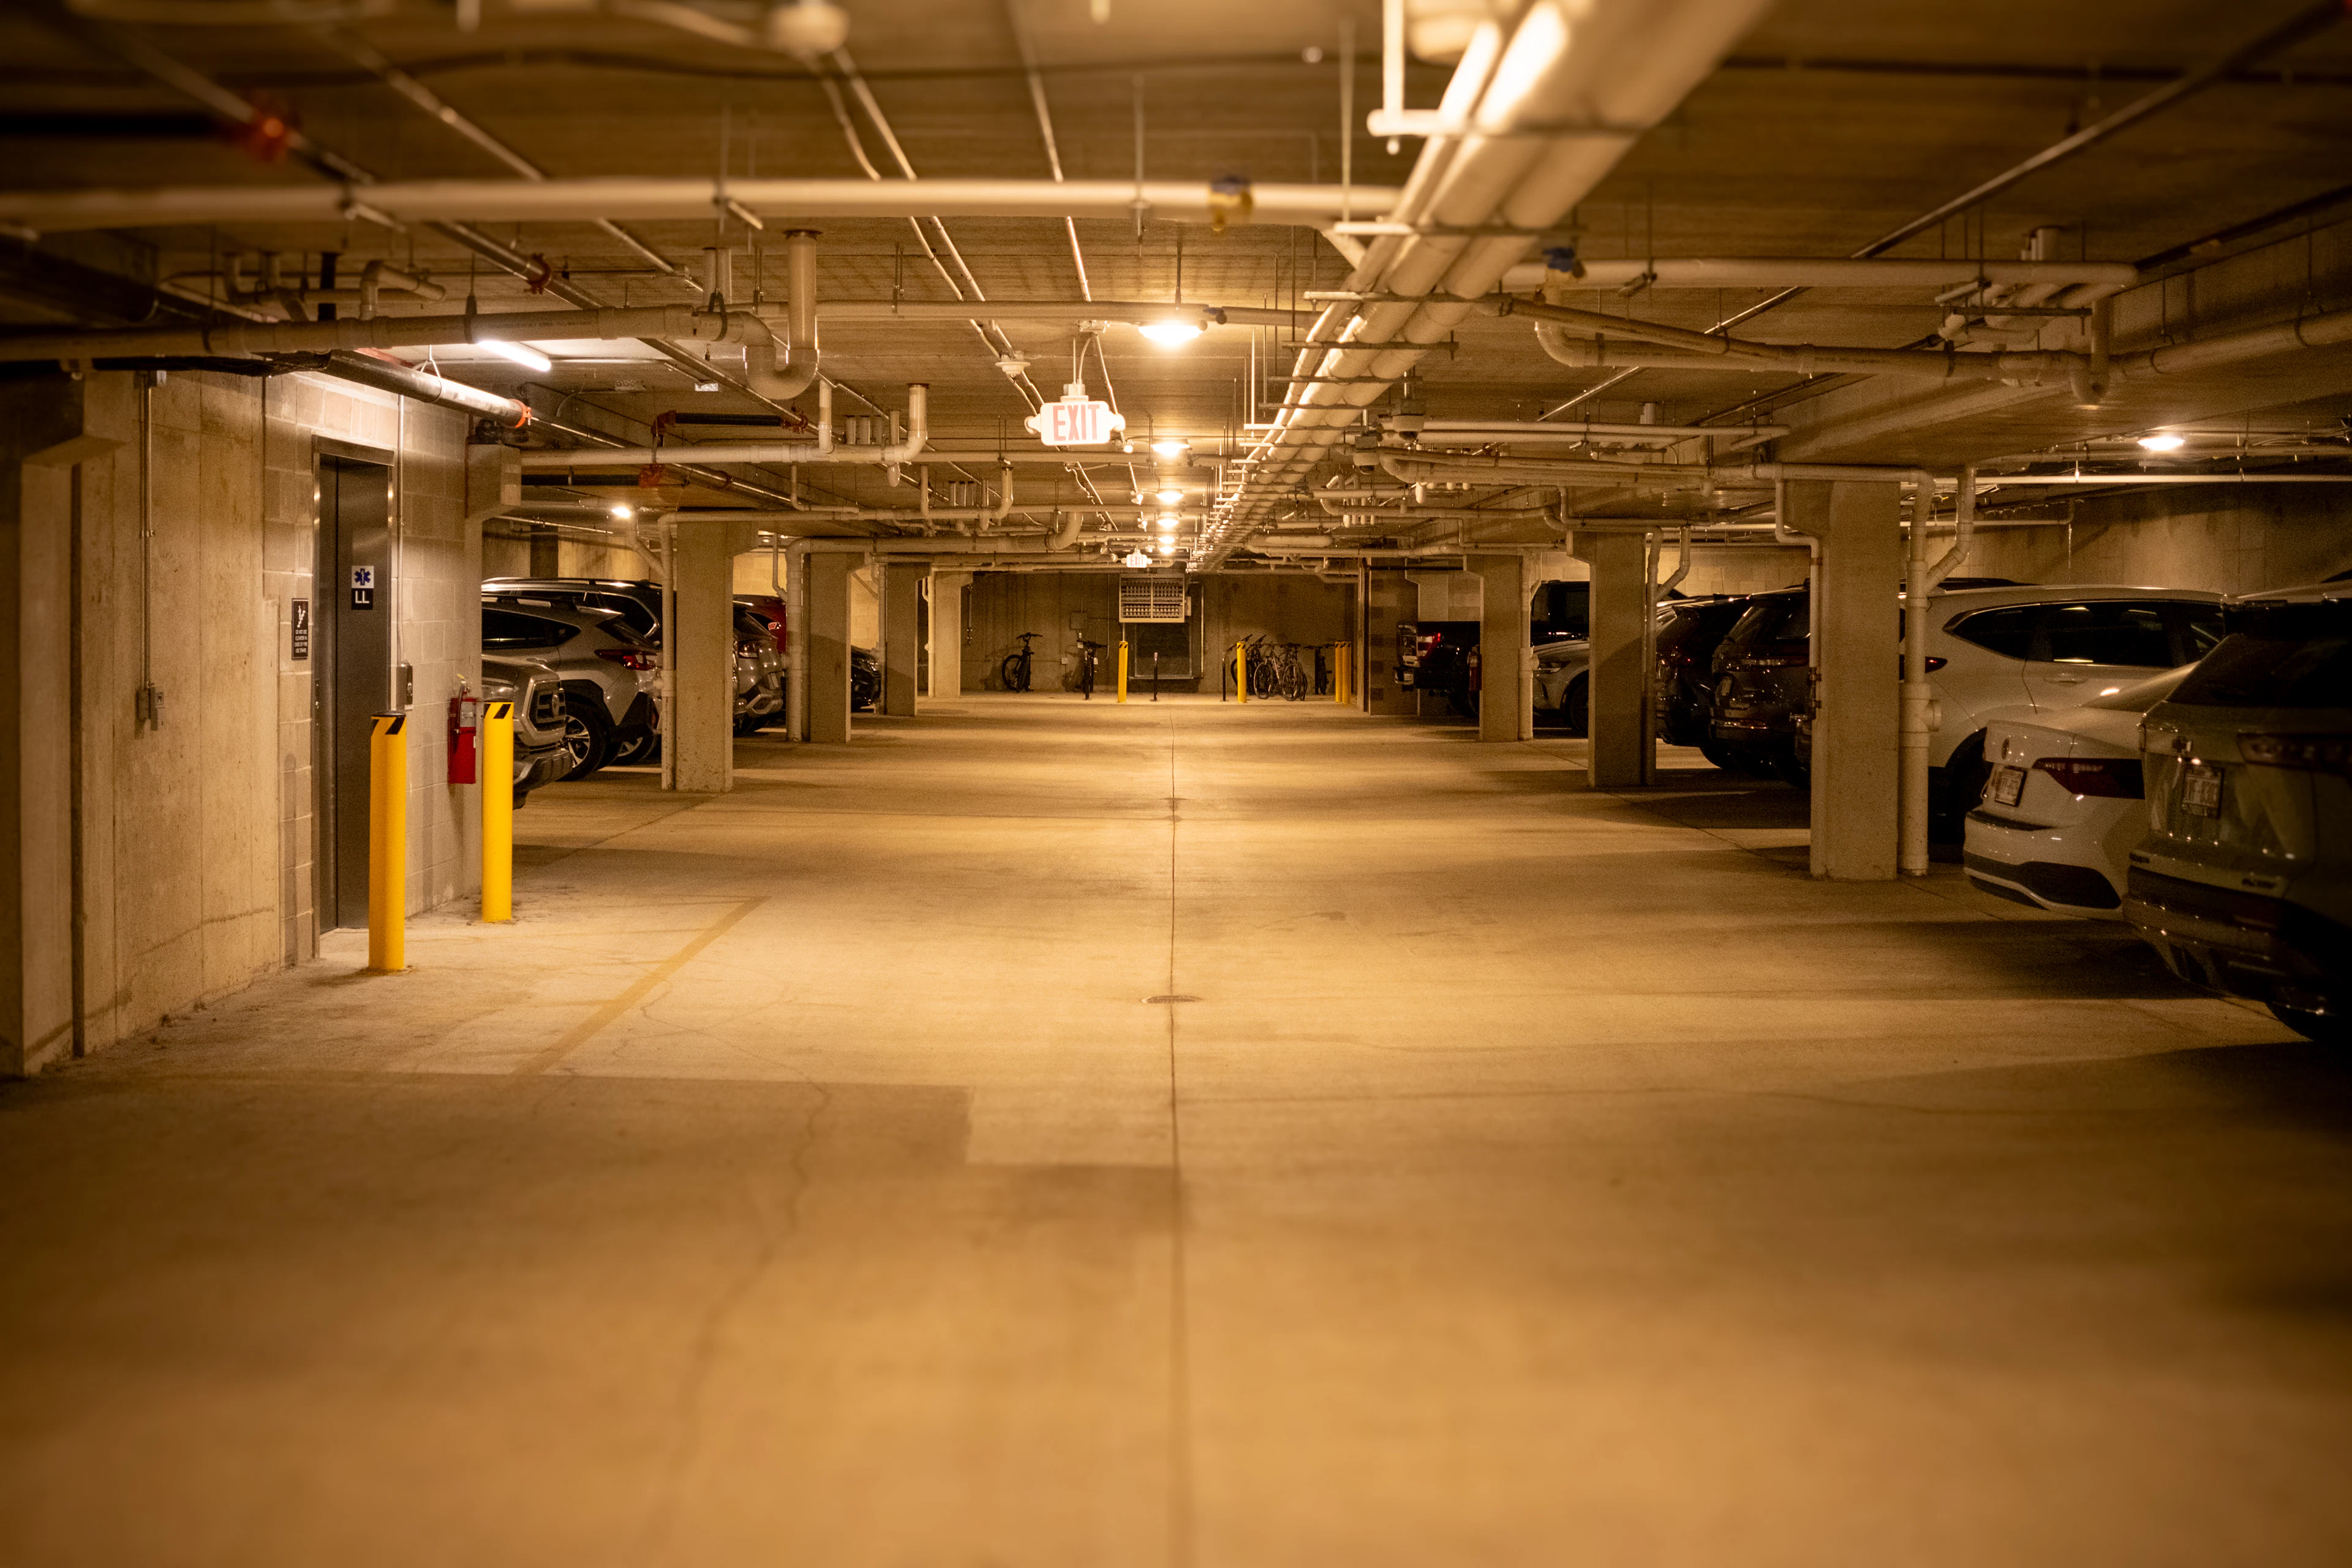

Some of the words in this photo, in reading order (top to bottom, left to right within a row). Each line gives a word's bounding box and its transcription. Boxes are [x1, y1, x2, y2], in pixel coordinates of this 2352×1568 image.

[1052, 404, 1100, 441] EXIT
[1130, 556, 1144, 566] EXIT
[355, 590, 370, 603] LL
